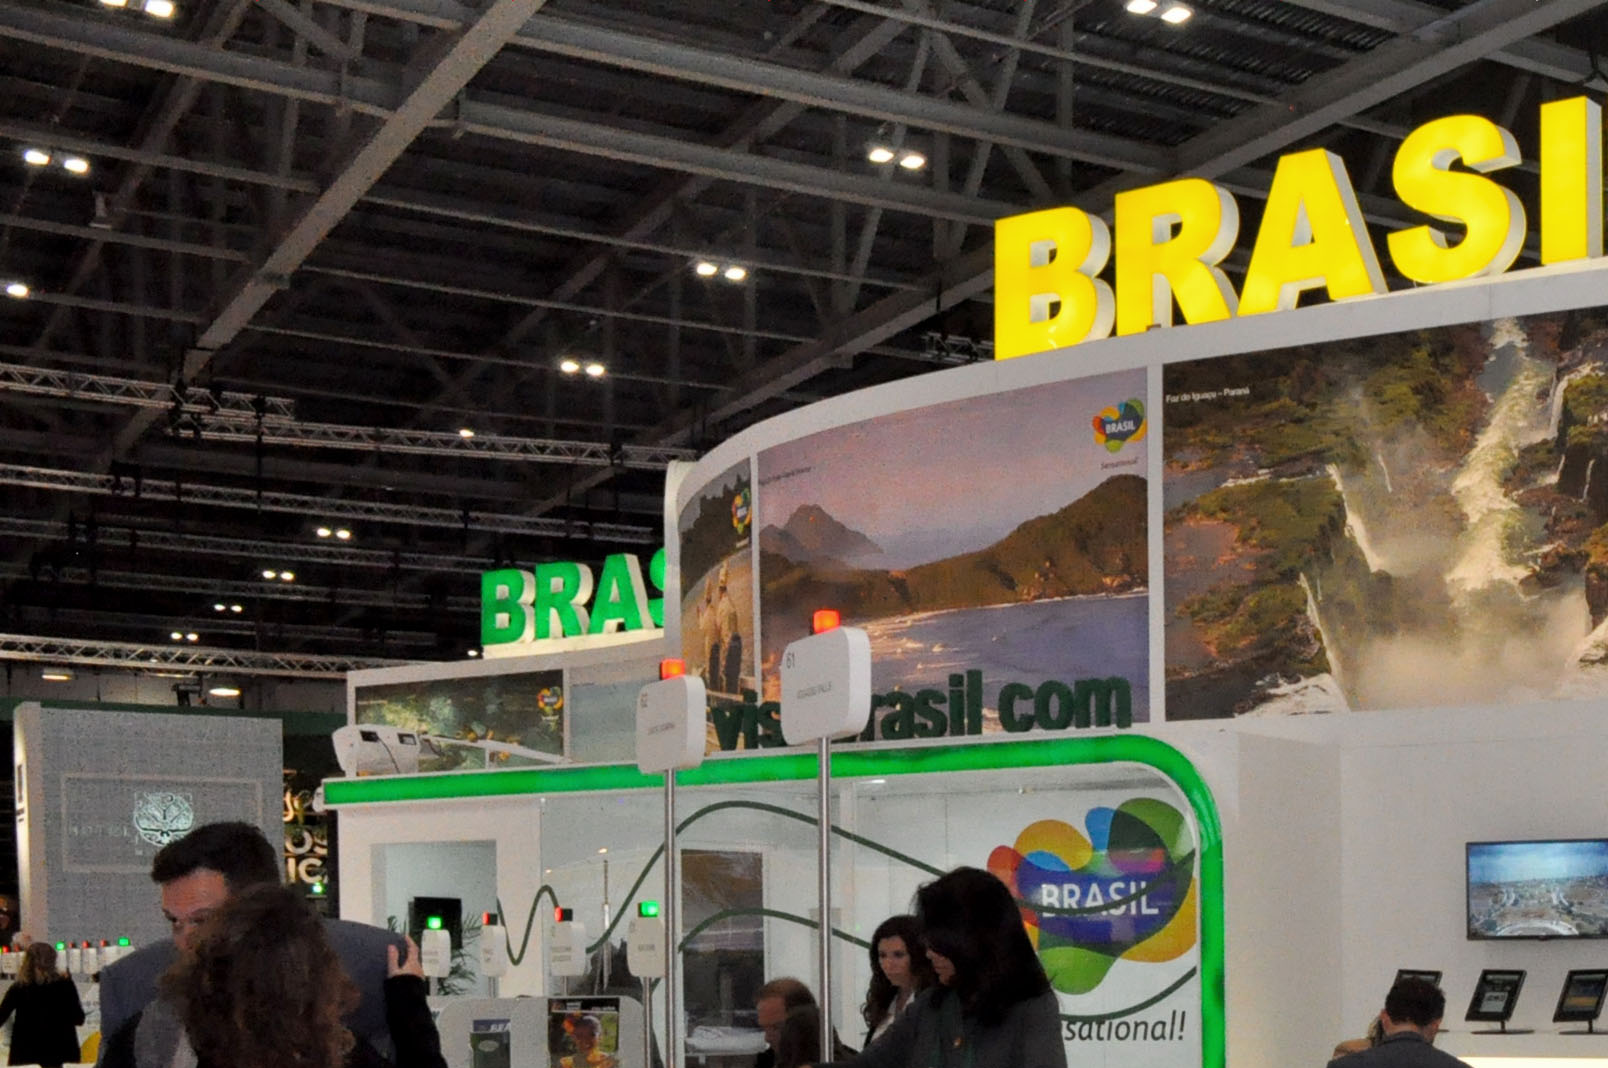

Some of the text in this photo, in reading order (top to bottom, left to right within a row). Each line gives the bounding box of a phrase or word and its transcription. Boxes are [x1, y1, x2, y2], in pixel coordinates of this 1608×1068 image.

[1105, 419, 1137, 435] BRASIL
[481, 547, 664, 646] BRA
[1040, 880, 1160, 918] BRASIL
[1063, 1009, 1187, 1041] sational!
